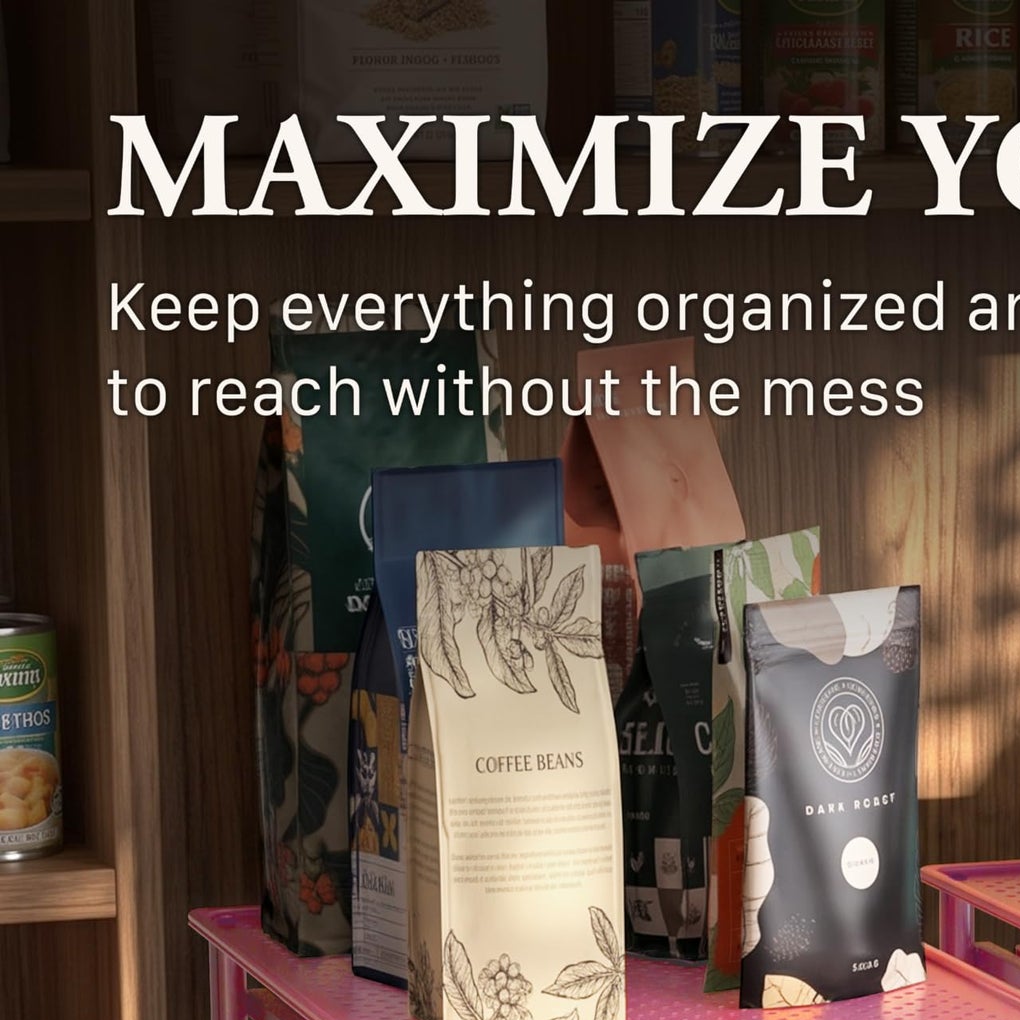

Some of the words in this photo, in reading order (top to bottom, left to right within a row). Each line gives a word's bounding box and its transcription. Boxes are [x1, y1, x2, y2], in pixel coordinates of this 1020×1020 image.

[955, 27, 1012, 48] RICE
[475, 754, 533, 773] COFFEE
[537, 751, 584, 771] BEANS
[805, 802, 845, 816] DARK
